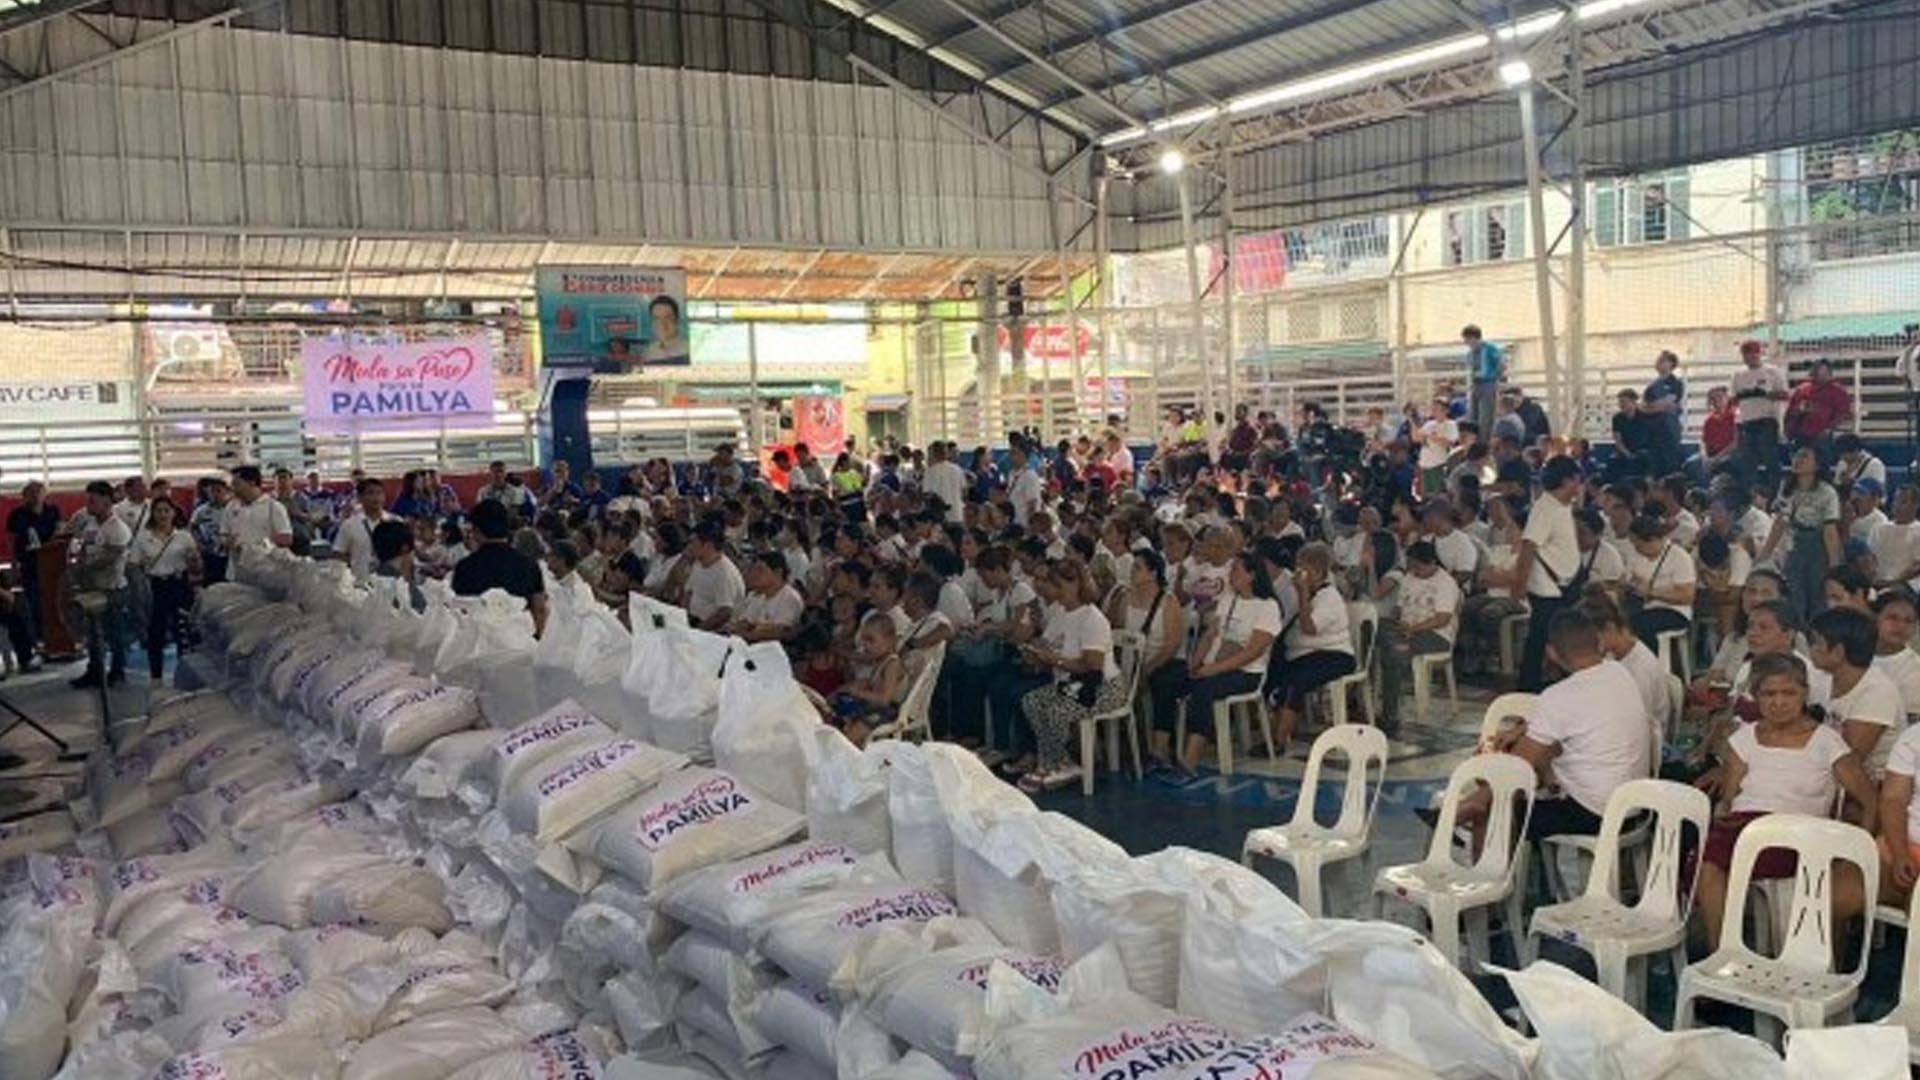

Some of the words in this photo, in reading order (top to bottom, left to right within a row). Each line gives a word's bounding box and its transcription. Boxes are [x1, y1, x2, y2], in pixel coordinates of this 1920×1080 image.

[324, 353, 390, 384] Mula
[394, 364, 413, 379] sa
[417, 347, 474, 383] Puso
[27, 385, 94, 401] CAFE
[331, 390, 473, 415] PAMILYA
[649, 793, 750, 843] PAMILYA
[1075, 1031, 1148, 1074] Mula
